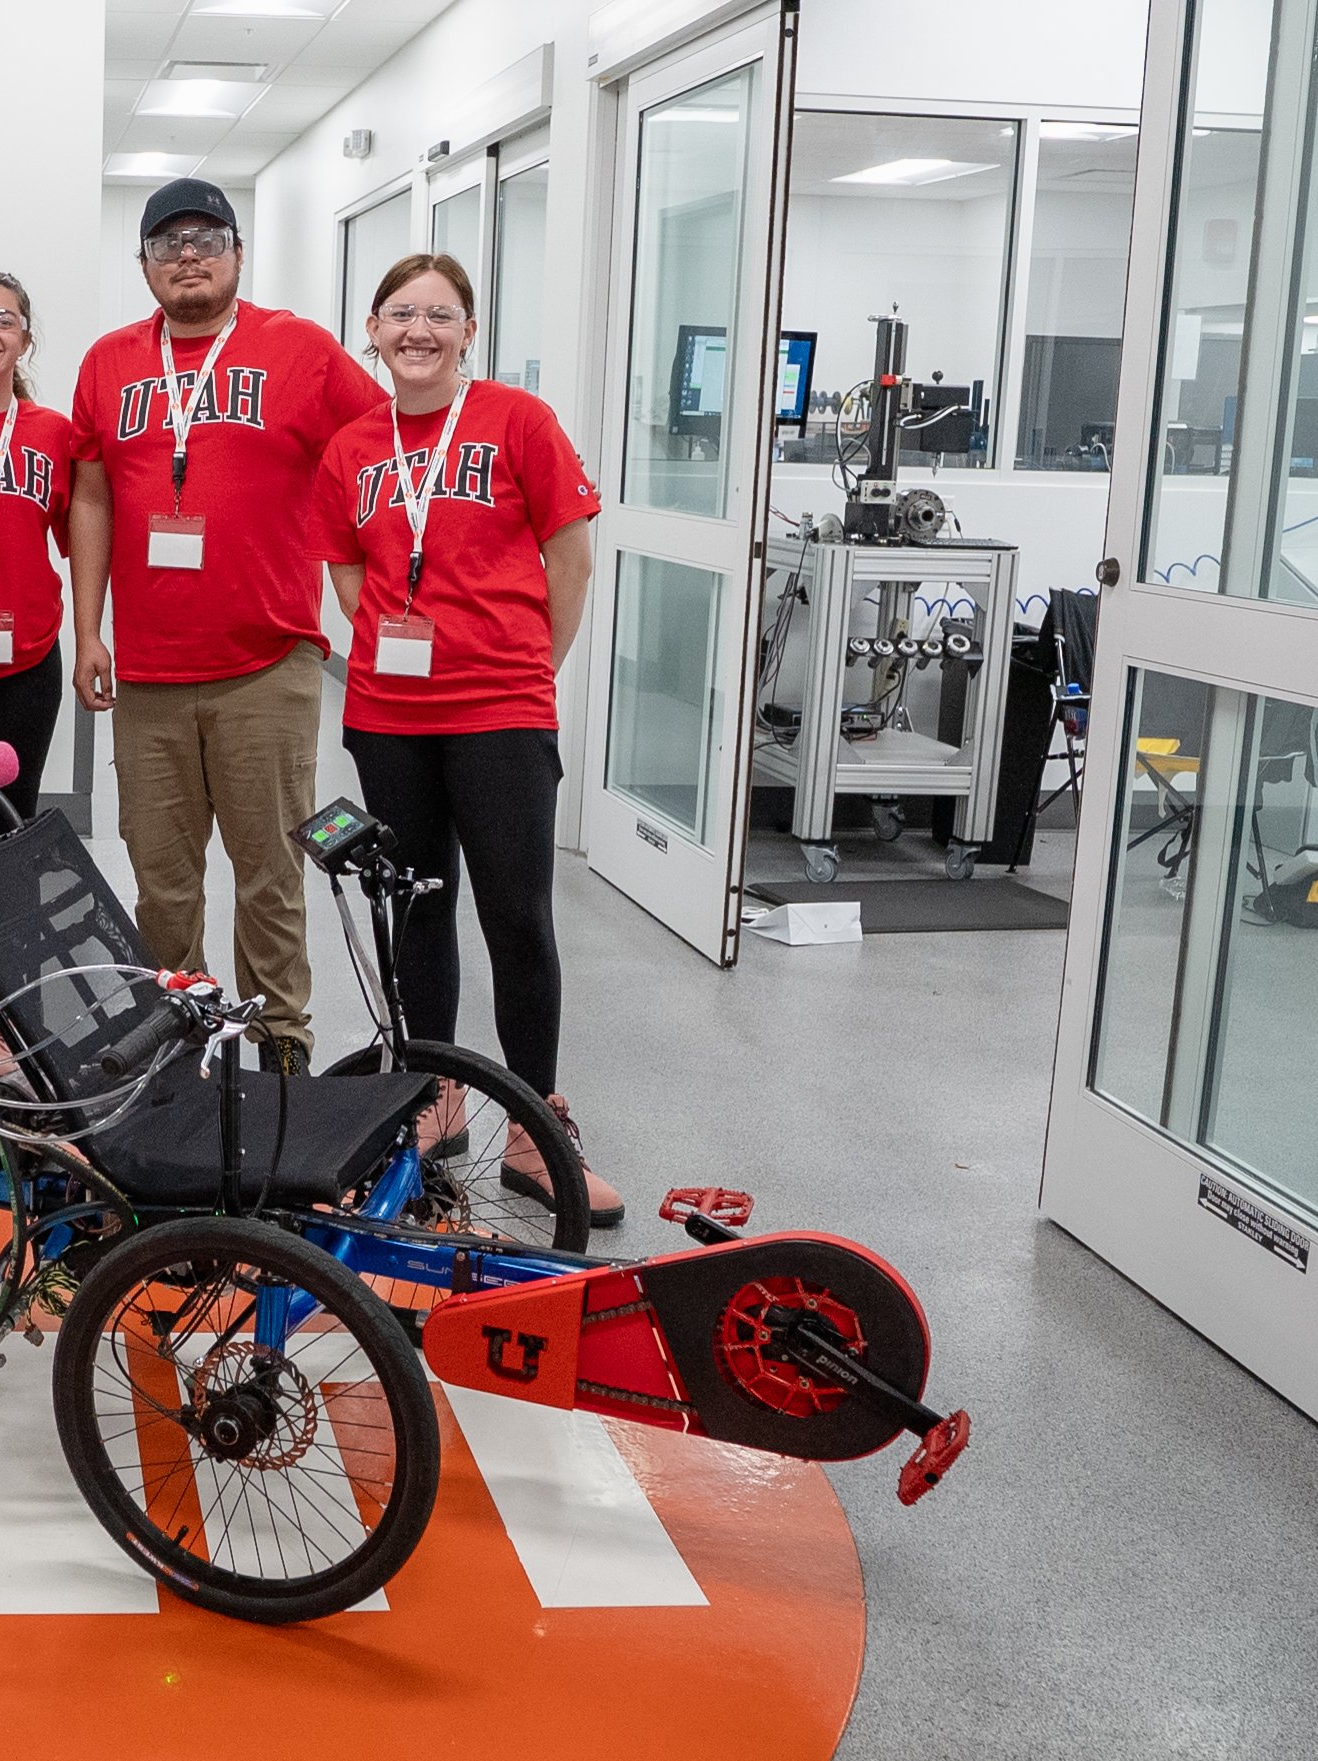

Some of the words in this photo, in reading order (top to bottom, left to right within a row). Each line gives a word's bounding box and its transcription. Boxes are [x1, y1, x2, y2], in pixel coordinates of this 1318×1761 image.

[117, 366, 267, 441] UTAH
[356, 442, 498, 528] UTAH
[1228, 1191, 1264, 1223] AUTOMATIC
[1264, 1214, 1290, 1239] SLIDING
[1290, 1231, 1309, 1252] DOOR
[1238, 1220, 1262, 1243] STANLEY
[482, 1325, 549, 1385] U
[815, 1354, 859, 1385] pinion
